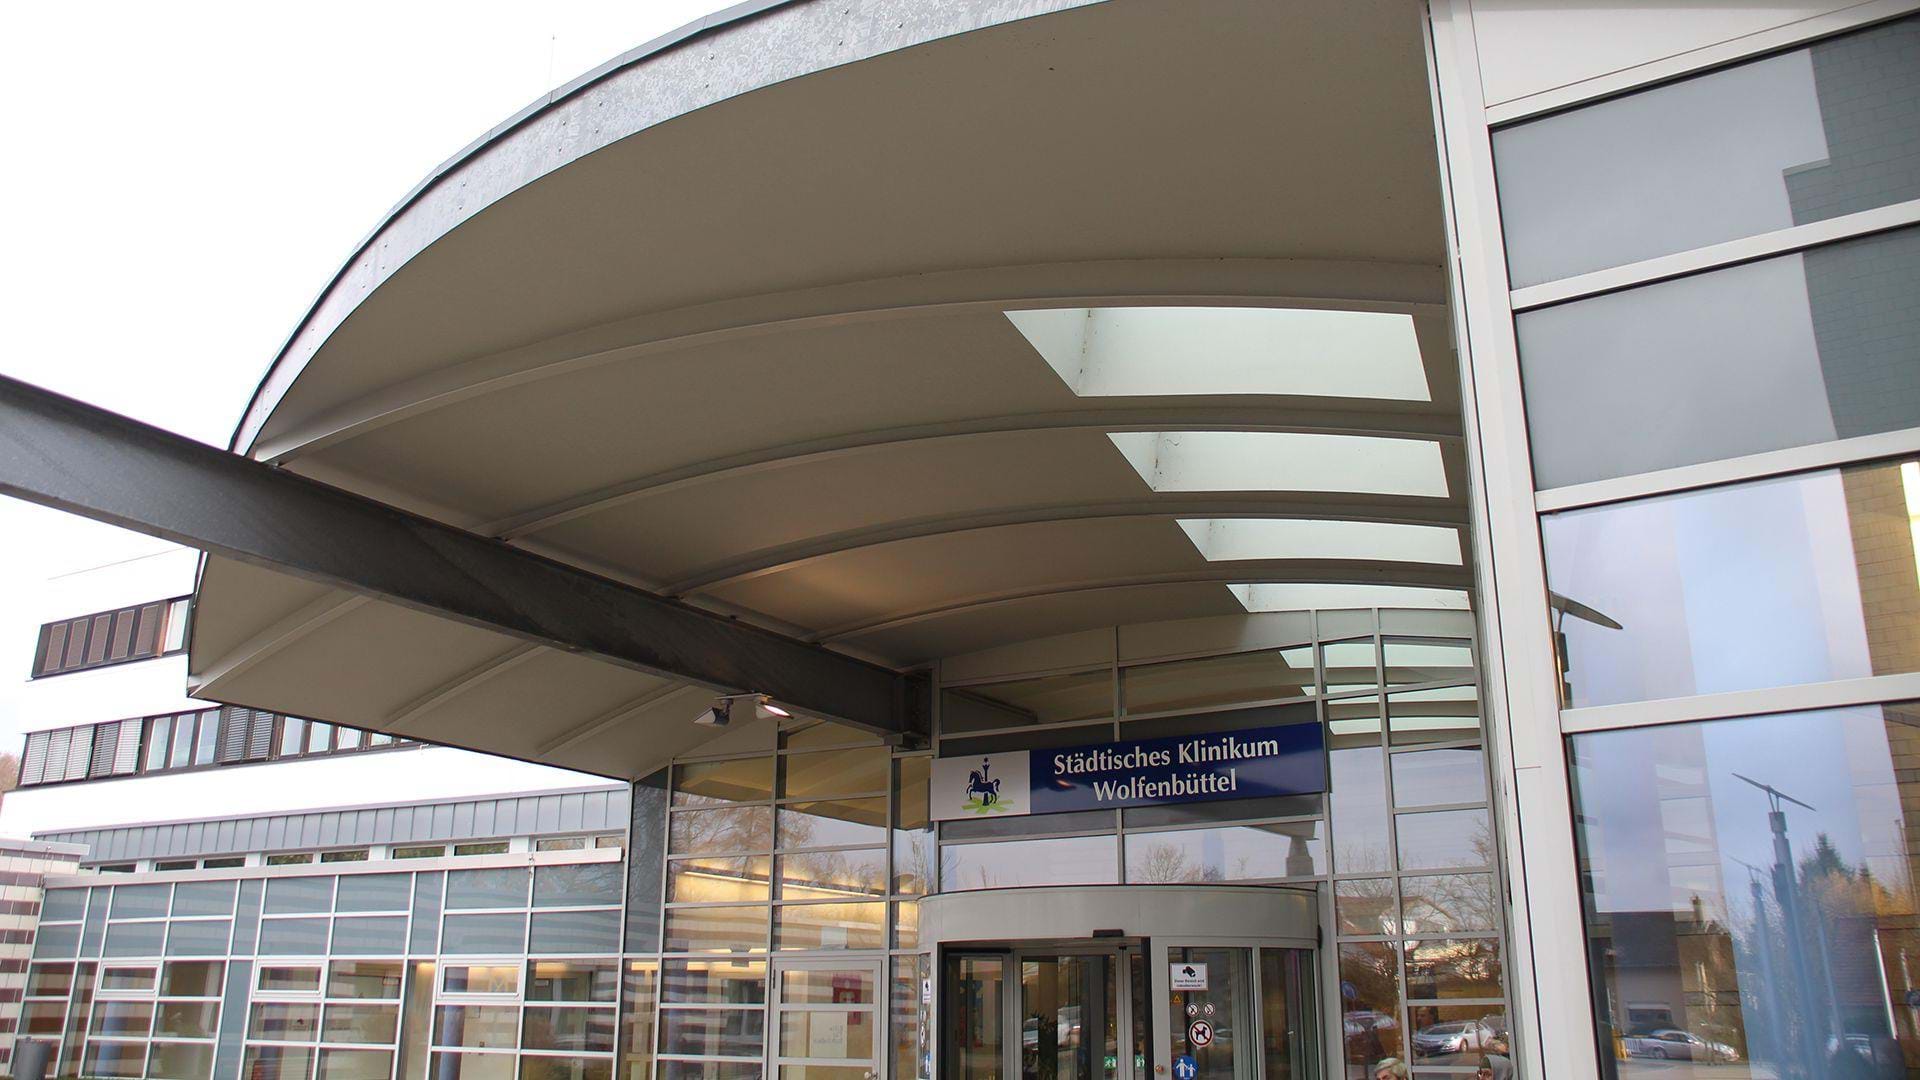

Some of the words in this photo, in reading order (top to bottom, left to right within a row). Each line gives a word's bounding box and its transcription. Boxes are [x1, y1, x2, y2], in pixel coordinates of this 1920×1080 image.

[1053, 745, 1172, 775] Städtisches
[1177, 736, 1279, 764] Klinikum
[1092, 768, 1237, 803] Wolfenbüttel
